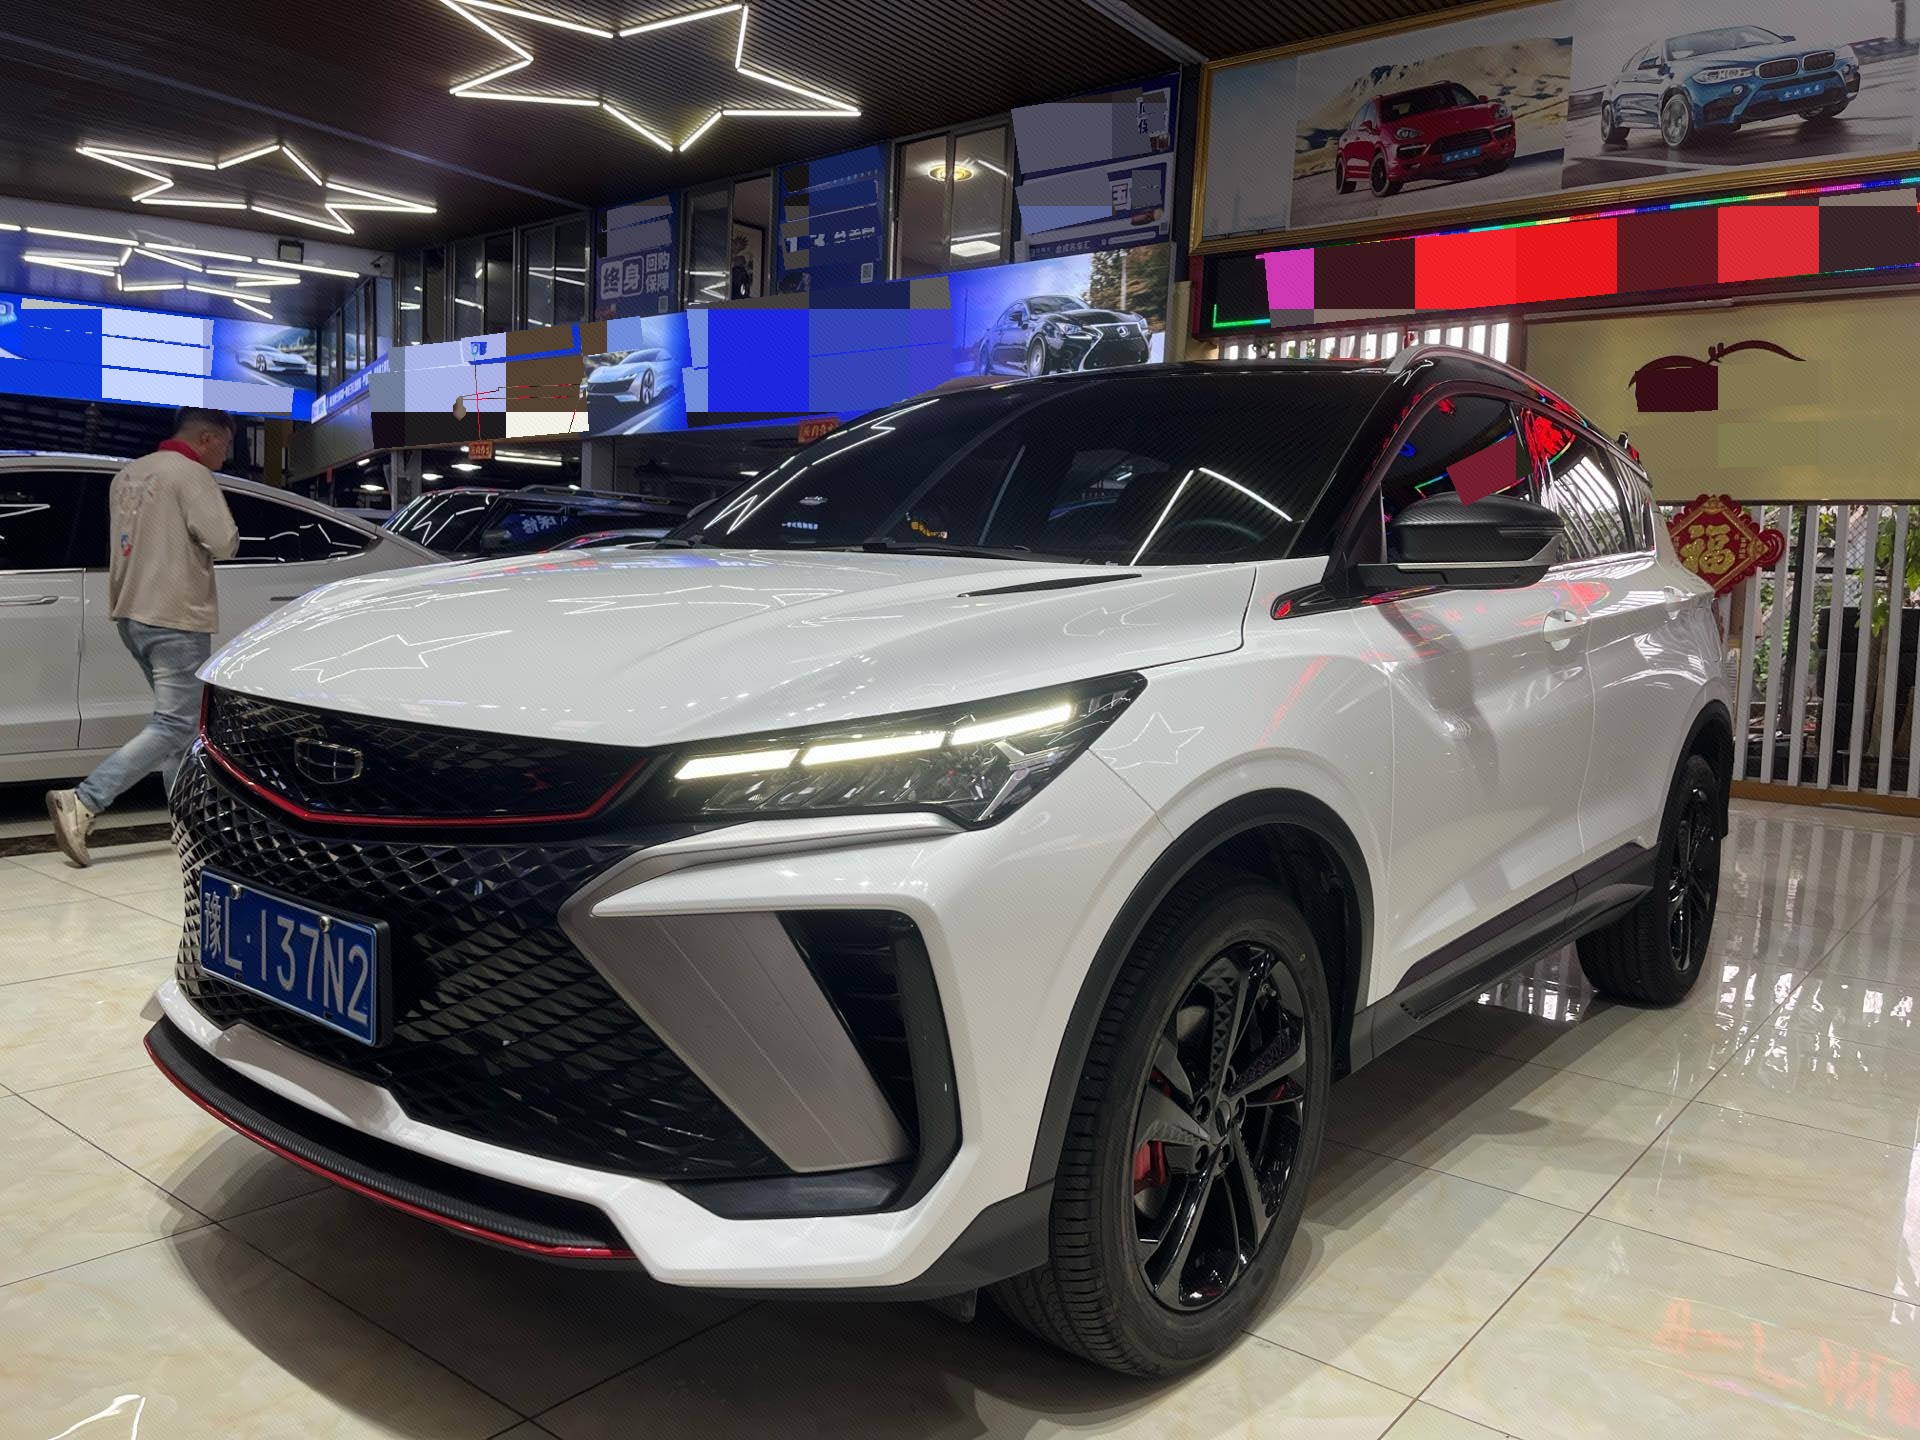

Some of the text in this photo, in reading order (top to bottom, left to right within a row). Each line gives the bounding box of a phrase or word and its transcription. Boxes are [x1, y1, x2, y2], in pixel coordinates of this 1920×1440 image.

[645, 252, 670, 272] 回购
[602, 261, 642, 295] 终身
[645, 271, 669, 294] 保障
[1680, 524, 1735, 575] 福
